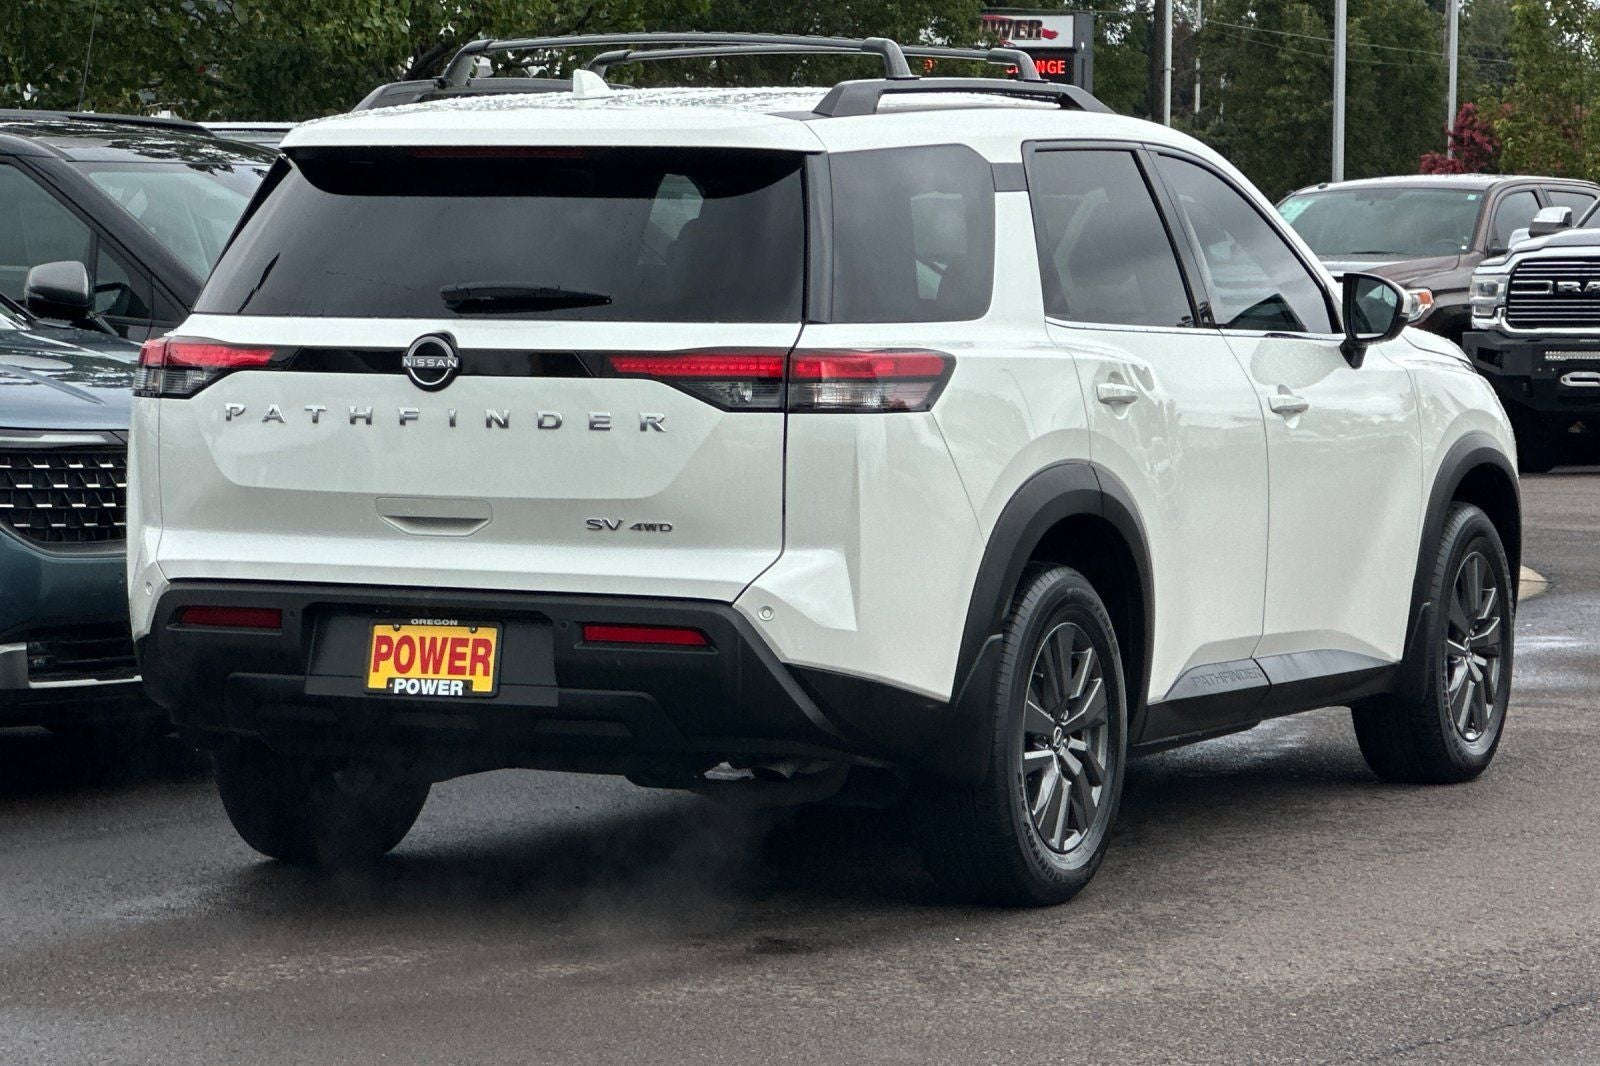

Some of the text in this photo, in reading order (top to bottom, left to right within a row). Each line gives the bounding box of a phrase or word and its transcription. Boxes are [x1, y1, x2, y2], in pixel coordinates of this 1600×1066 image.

[403, 357, 458, 368] NISSAN
[224, 403, 667, 433] PATHFINDER
[585, 518, 673, 533] SV 4WD
[410, 618, 458, 626] OREGON
[372, 634, 493, 677] POWER
[393, 678, 464, 696] POWER
[1190, 667, 1263, 689] PATHFINDER
